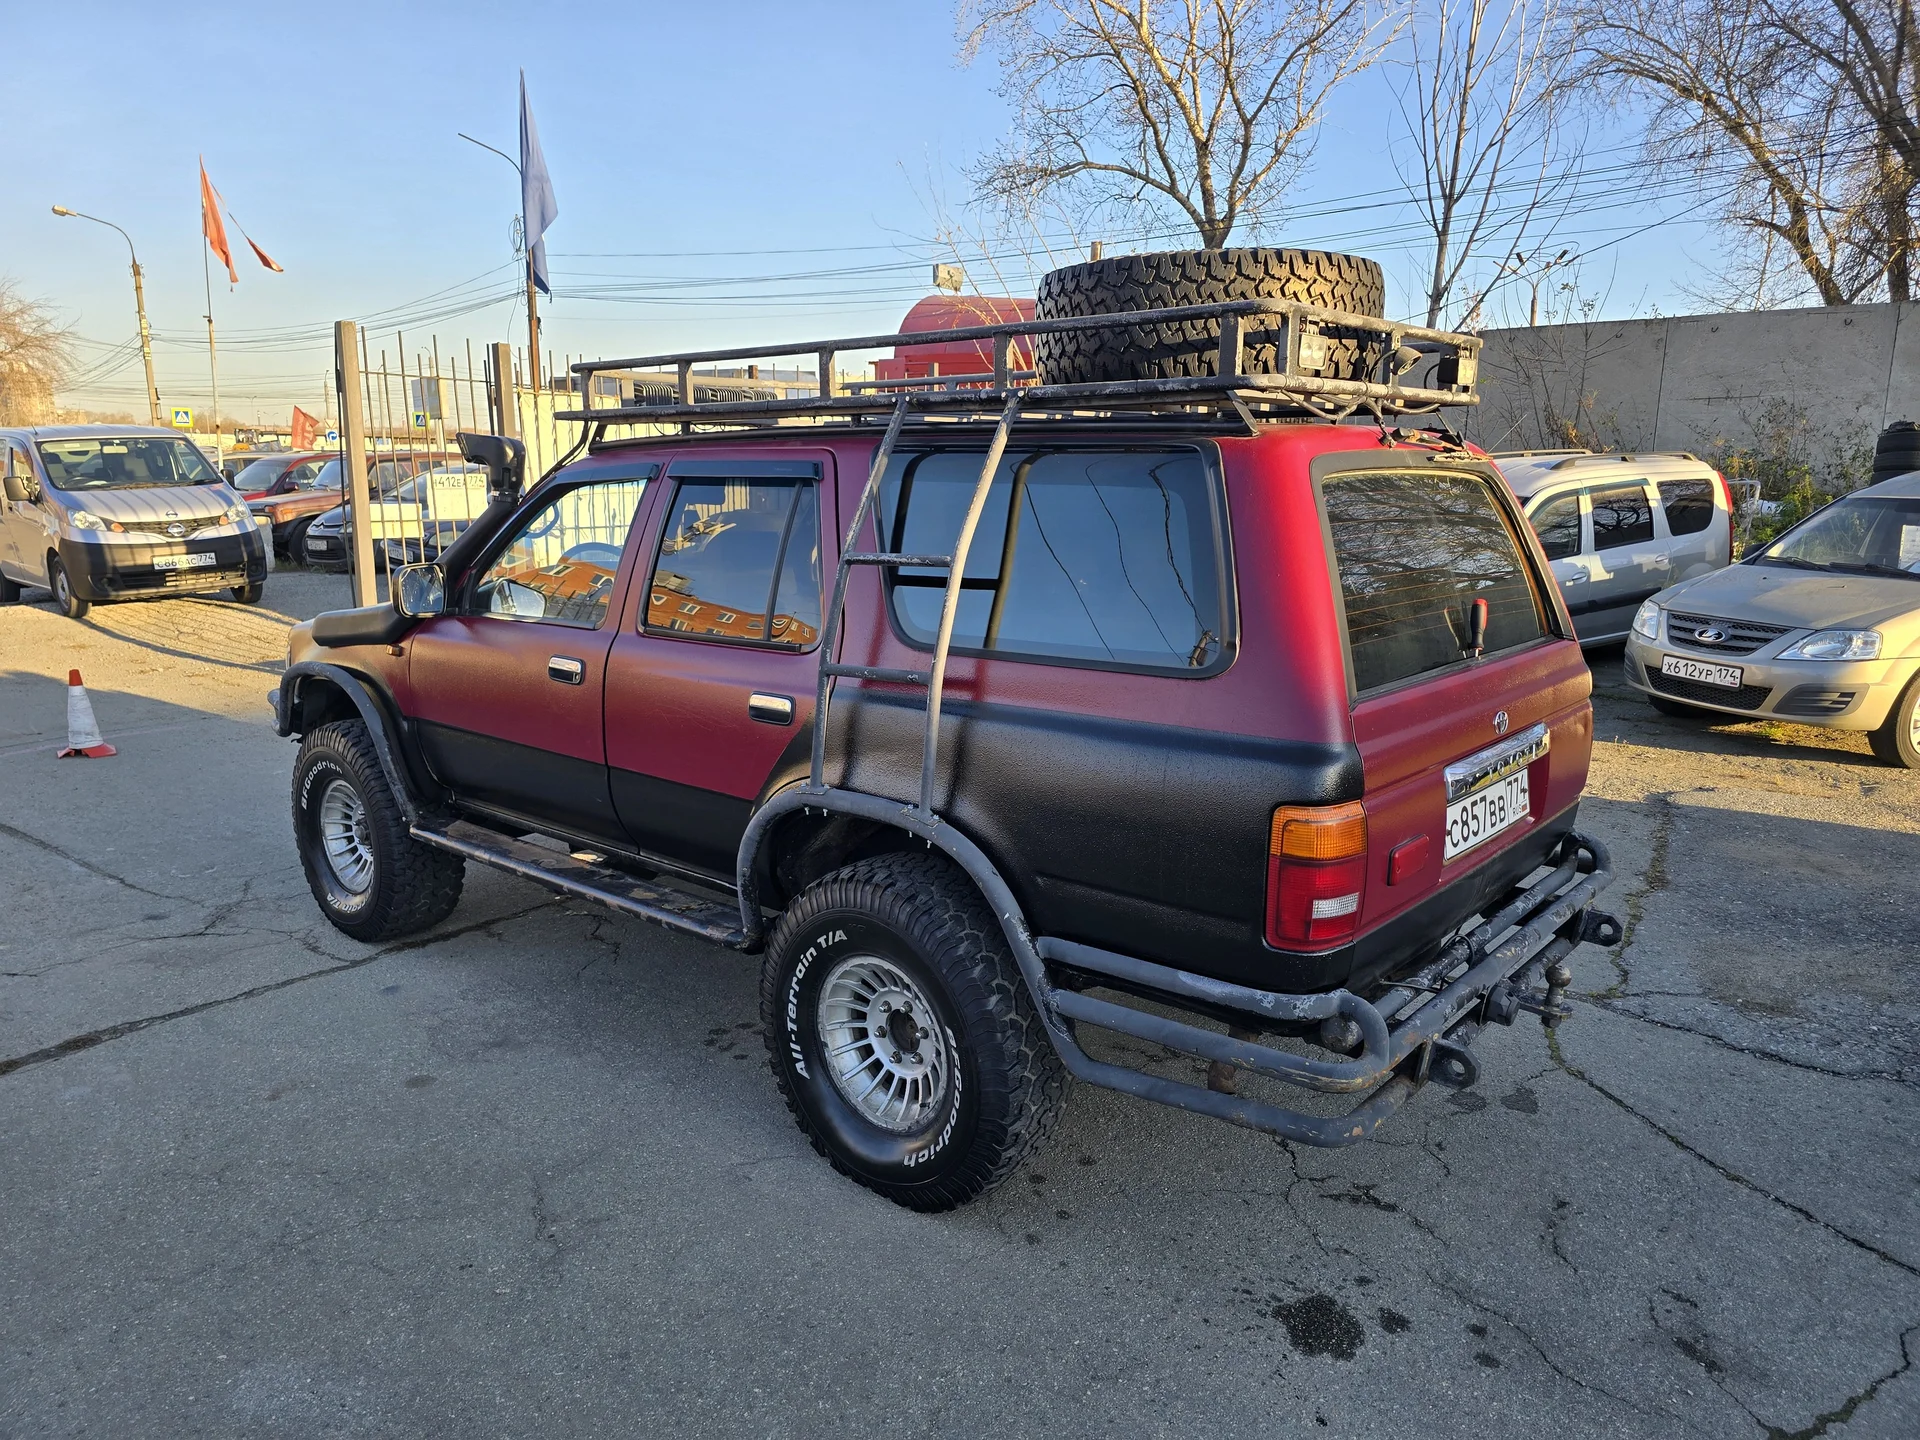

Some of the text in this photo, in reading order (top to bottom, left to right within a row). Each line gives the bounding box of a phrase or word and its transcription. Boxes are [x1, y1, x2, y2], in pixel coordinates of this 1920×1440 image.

[198, 554, 214, 563] 774
[1665, 660, 1736, 681] Х612УР 174
[1487, 743, 1540, 781] TOYOTA
[301, 760, 343, 811] BFGoodrich
[1450, 773, 1528, 848] С857ВВ 774
[1512, 803, 1522, 817] RUS
[786, 928, 848, 1080] All-Terrain T/A
